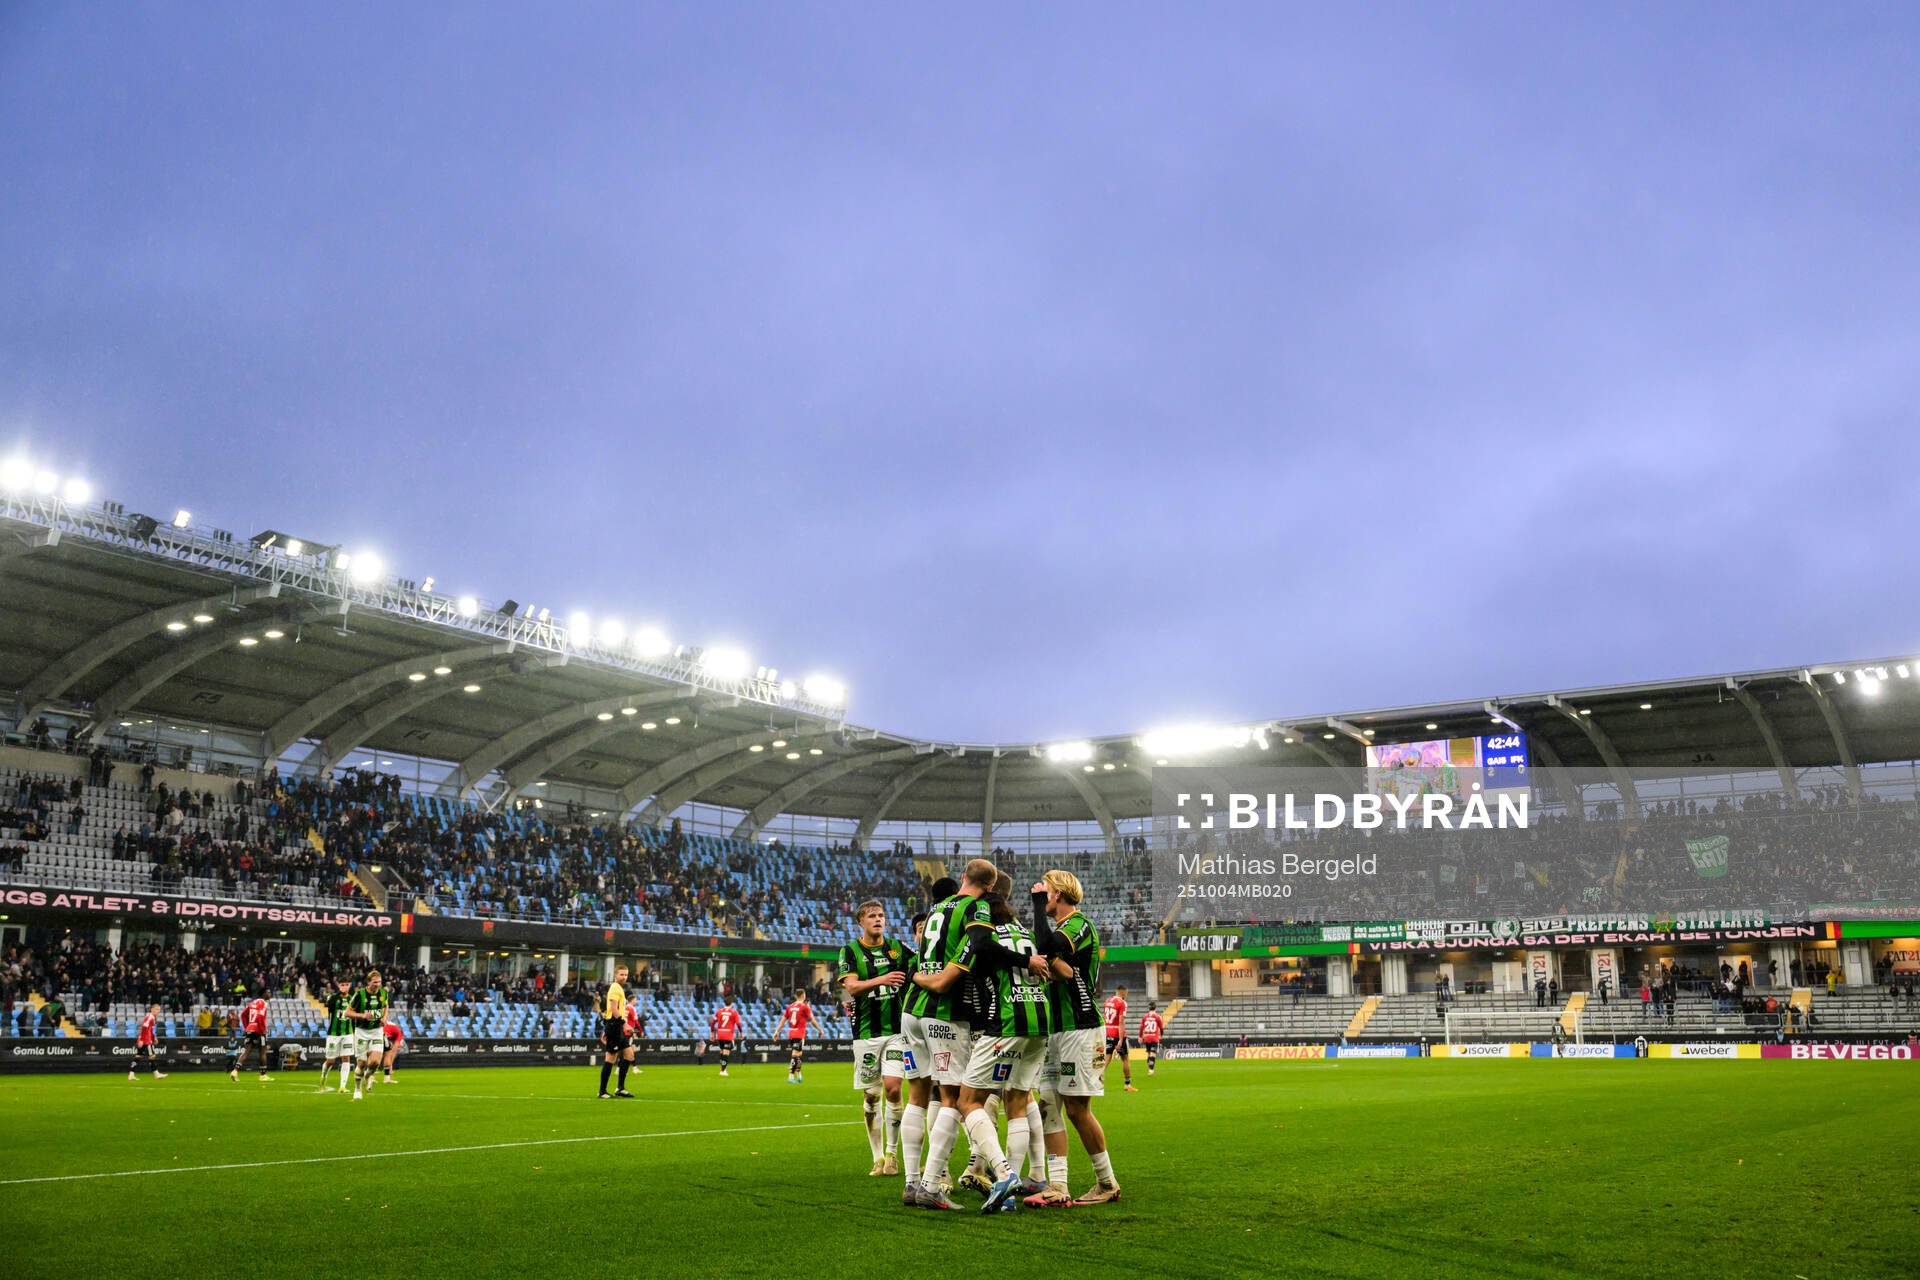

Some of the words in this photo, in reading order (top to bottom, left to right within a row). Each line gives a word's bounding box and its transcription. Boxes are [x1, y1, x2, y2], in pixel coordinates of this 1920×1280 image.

[1487, 736, 1520, 749] 42:44
[1486, 756, 1507, 765] GAIS
[1510, 755, 1524, 764] IFK
[52, 894, 146, 912] ATLET-
[151, 900, 170, 914] &
[175, 902, 393, 927] IDROTTSSÄLLSKAP
[1567, 913, 1649, 932] PREPPENS
[1676, 909, 1764, 930] STÅPLATS
[924, 912, 945, 959] 9
[1369, 942, 1386, 951] VI
[1390, 941, 1430, 949] SKA
[1433, 937, 1520, 949] SJUNGA
[1554, 934, 1599, 944] DET
[1012, 986, 1043, 995] NORDIC
[721, 1015, 730, 1027] 7
[790, 1012, 797, 1026] 4
[928, 1024, 950, 1032] GOOD
[1144, 1021, 1157, 1032] 20
[928, 1032, 957, 1040] ADVICE
[13, 1046, 44, 1055] Gamla
[47, 1046, 73, 1055] Ullevi
[202, 1046, 226, 1054] Gaml
[309, 1046, 328, 1054] Ullev
[428, 1045, 449, 1053] Gamla
[450, 1045, 468, 1053] Ullevi
[1236, 1047, 1323, 1058] BYGGMAX
[1467, 1045, 1504, 1055] isover
[1690, 1045, 1730, 1055] weber
[1791, 1045, 1912, 1060] BEVEGO
[993, 1050, 1022, 1059] RASTA
[1168, 1050, 1221, 1059] HYDROSCAND
